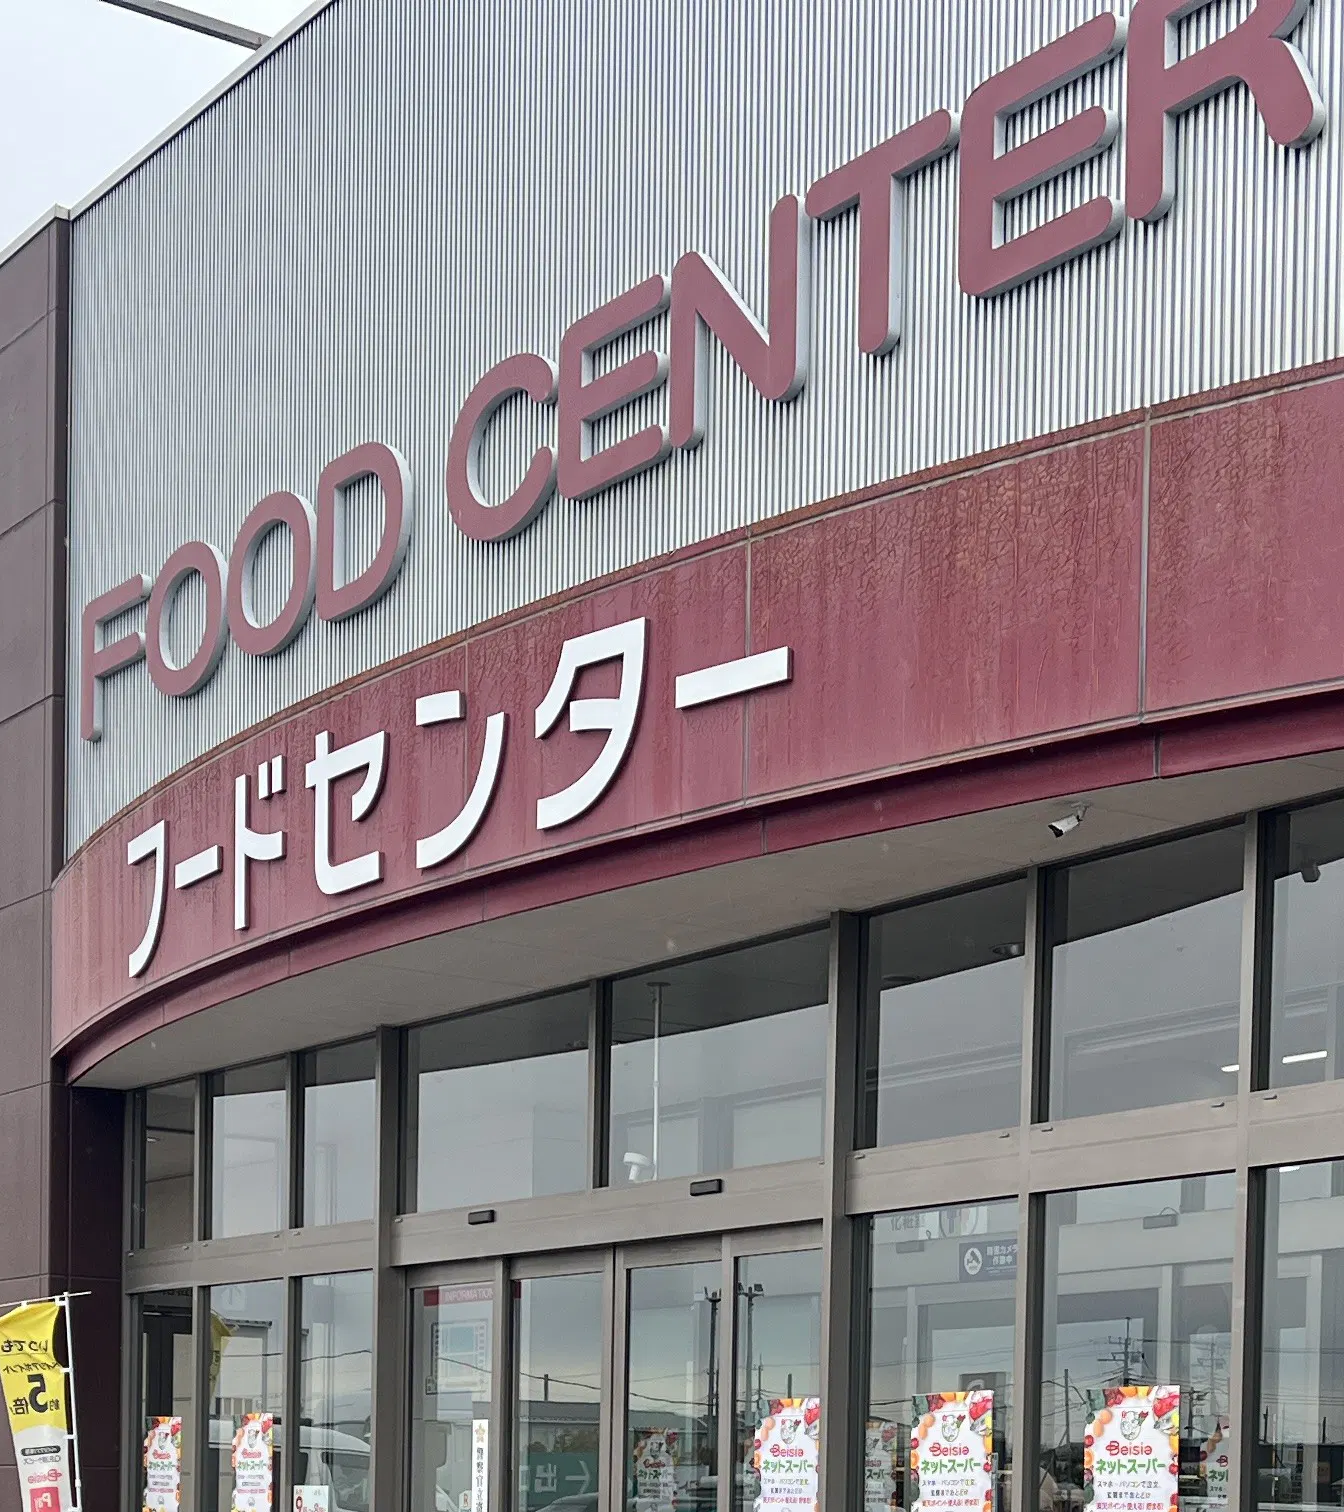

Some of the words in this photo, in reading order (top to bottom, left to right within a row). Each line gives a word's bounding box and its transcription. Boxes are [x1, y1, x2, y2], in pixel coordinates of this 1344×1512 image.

[80, 441, 412, 742] FOOD
[446, 0, 1327, 543] CENTER
[125, 616, 793, 980] フードセンター
[769, 1443, 804, 1458] Beisia
[929, 1442, 970, 1457] Beisia
[1105, 1440, 1153, 1456] Beisia
[762, 1459, 815, 1474] ネットスーパー
[920, 1458, 981, 1475] ネットスーパー
[1095, 1458, 1166, 1475] ネットスーパー
